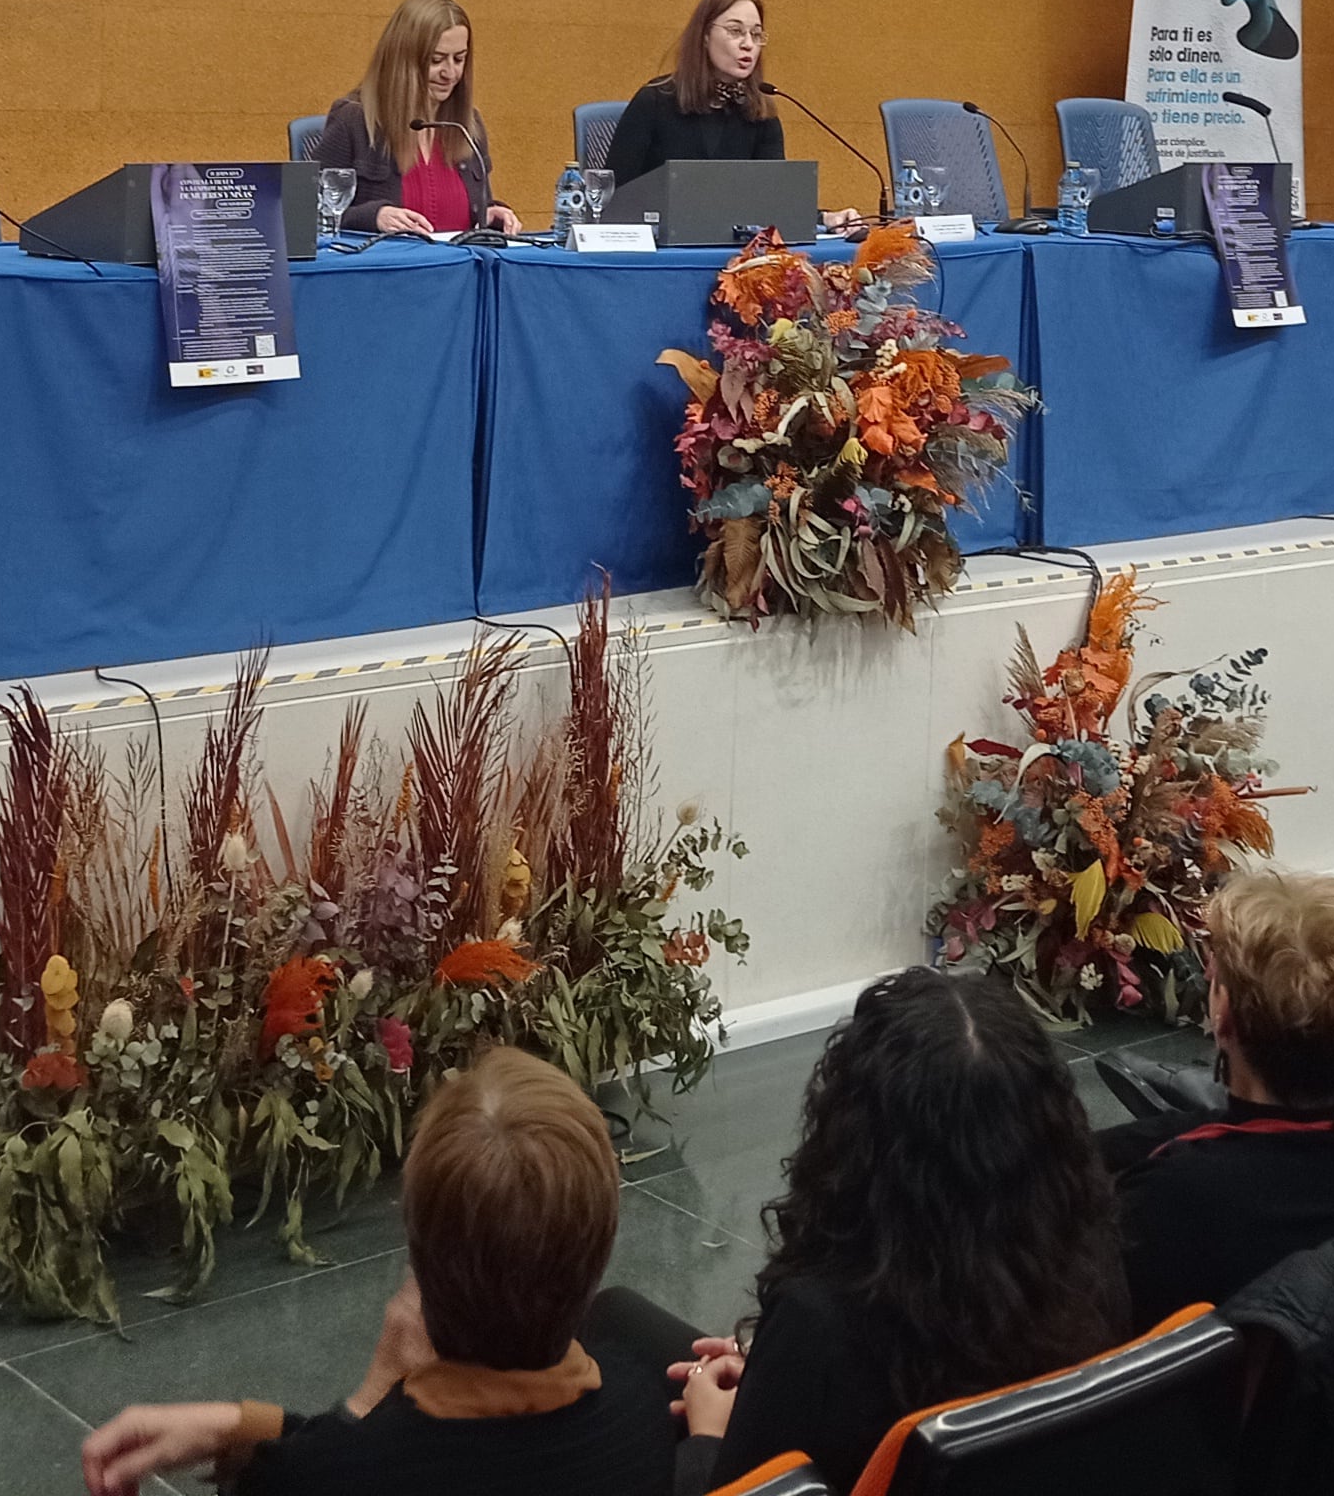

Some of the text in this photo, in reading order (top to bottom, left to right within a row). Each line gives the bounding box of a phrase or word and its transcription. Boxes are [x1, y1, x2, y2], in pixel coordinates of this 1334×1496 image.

[1151, 26, 1212, 42] Para ti es
[1149, 45, 1223, 63] sólo dinero.
[1147, 68, 1240, 83] Para ella es un
[1146, 88, 1219, 103] sufrimiento
[1162, 109, 1199, 123] tiene
[1204, 110, 1245, 126] precio.
